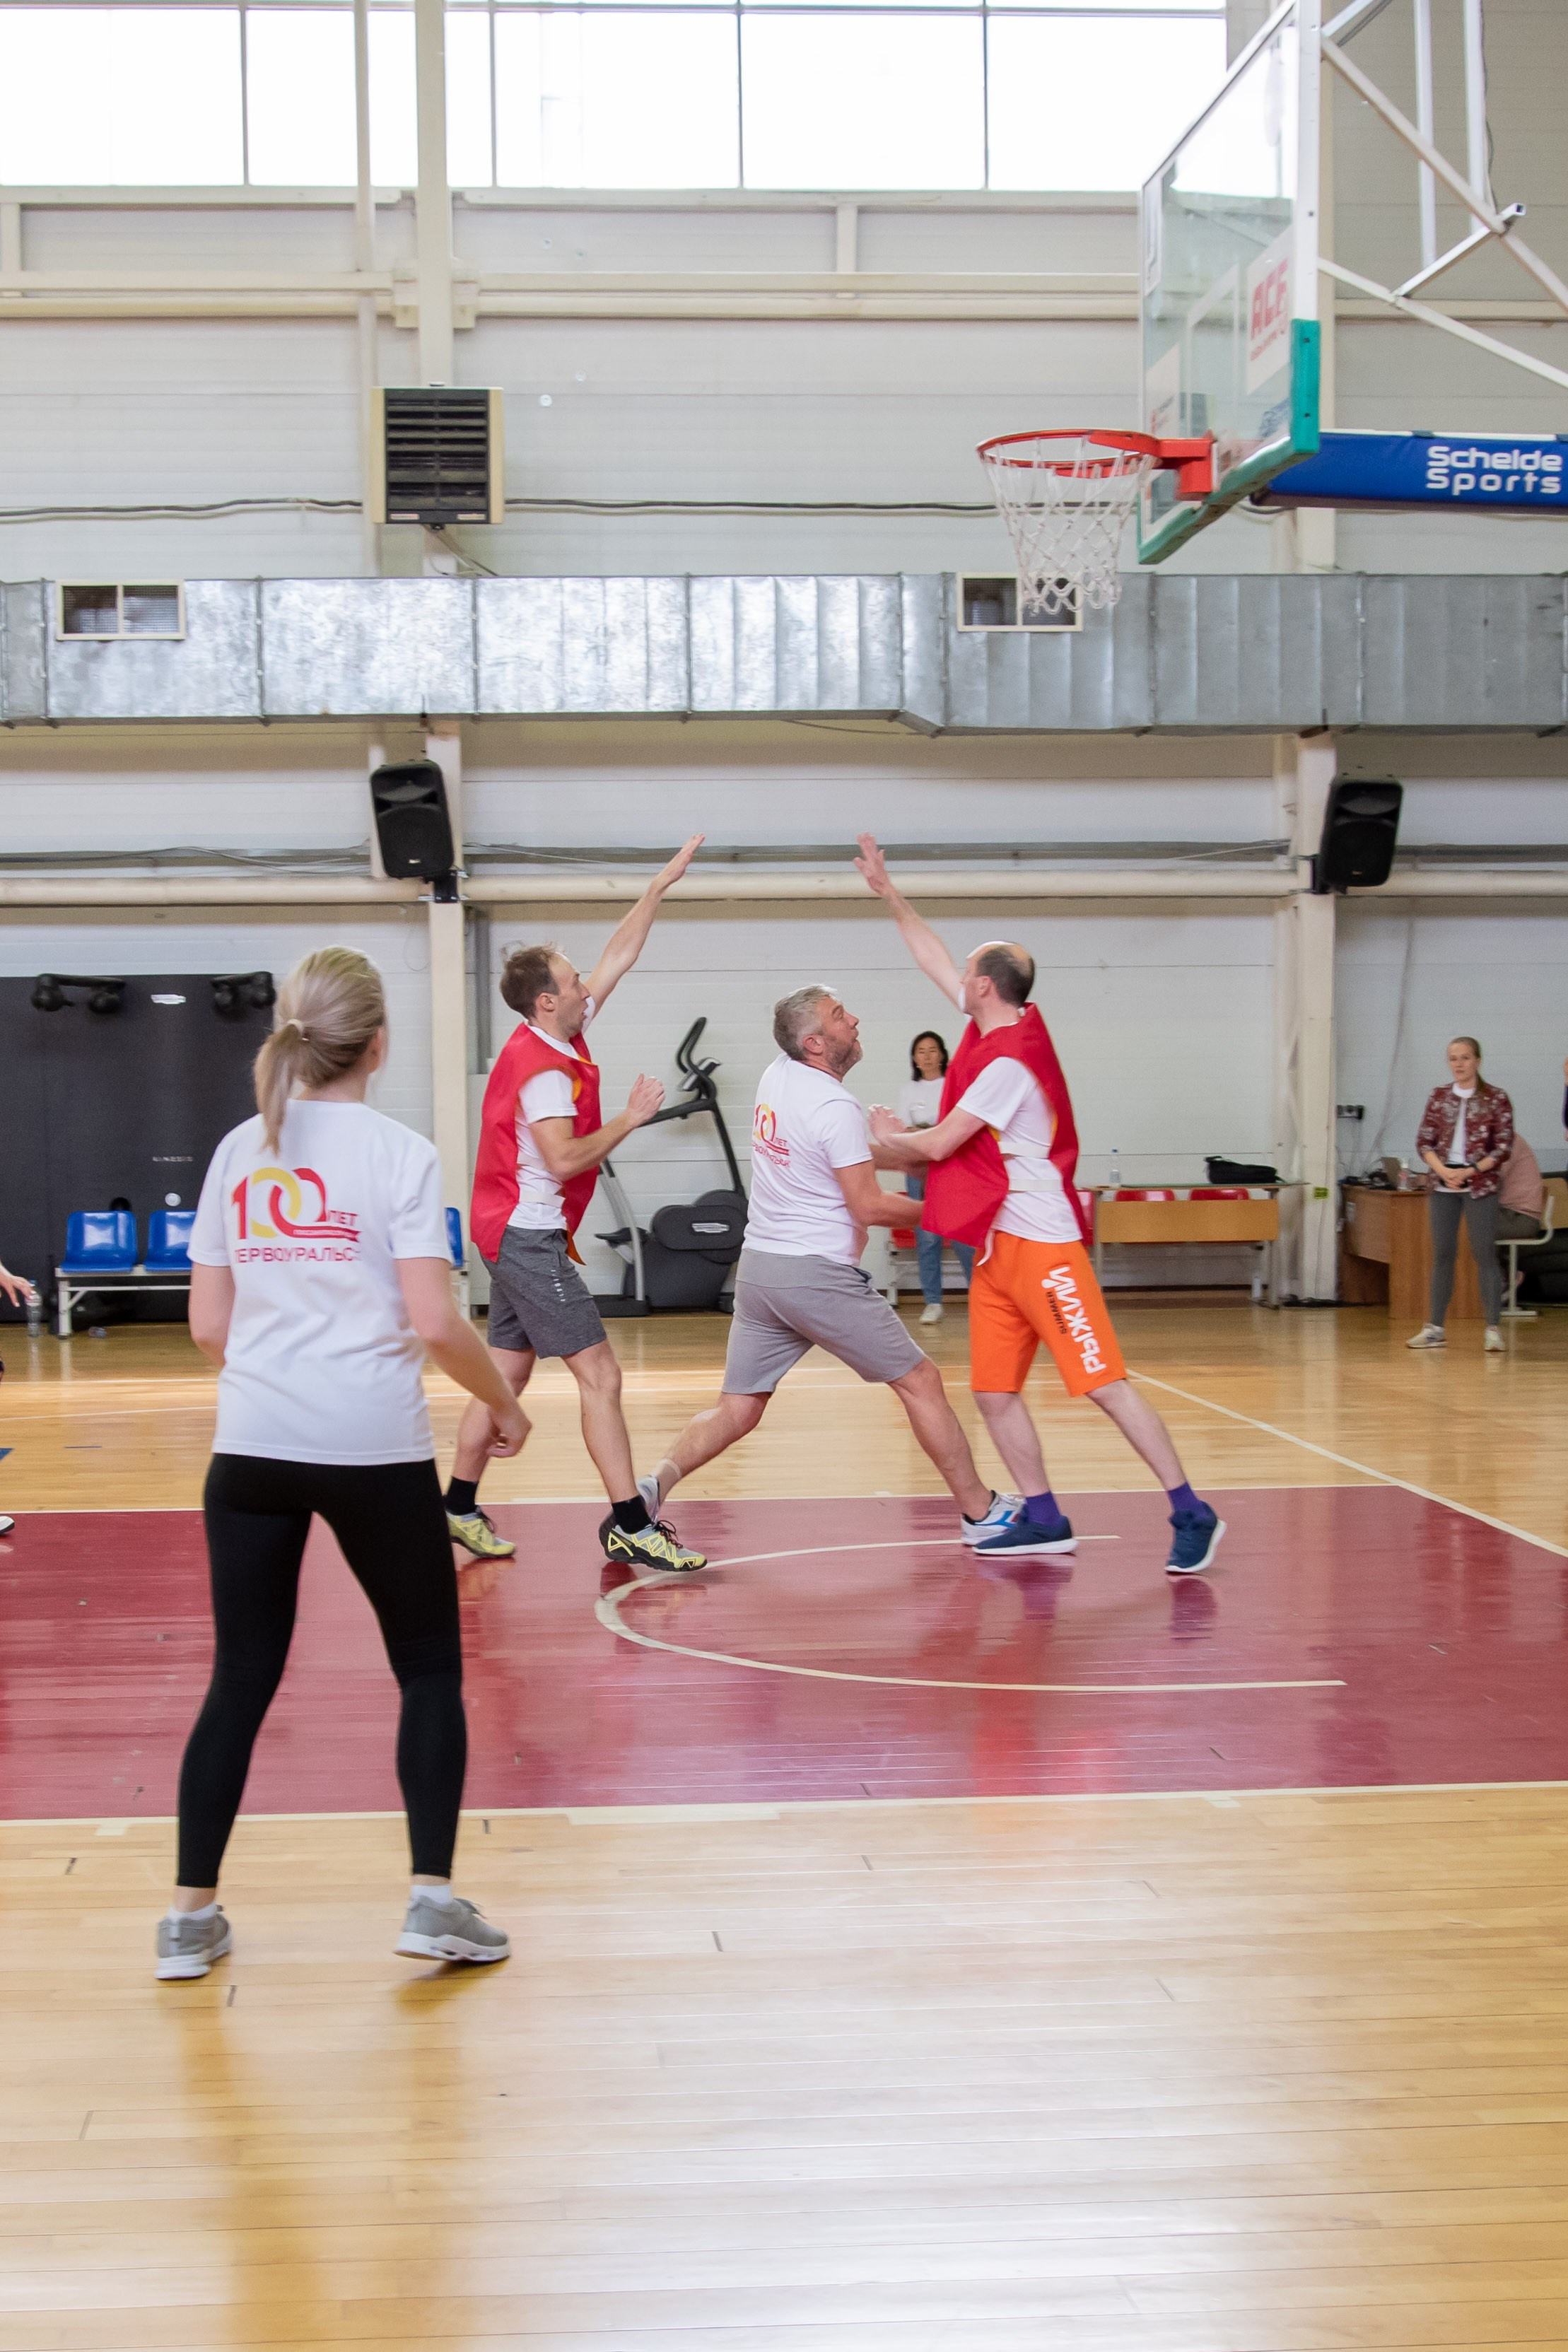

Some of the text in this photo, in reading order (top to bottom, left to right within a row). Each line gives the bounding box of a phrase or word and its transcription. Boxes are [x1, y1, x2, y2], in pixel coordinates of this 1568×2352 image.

[1425, 467, 1562, 496] Sports
[1427, 445, 1563, 472] Schelde
[231, 1166, 359, 1239] 100 ЛЕТ
[1041, 1266, 1107, 1374] РЫЖИЙ
